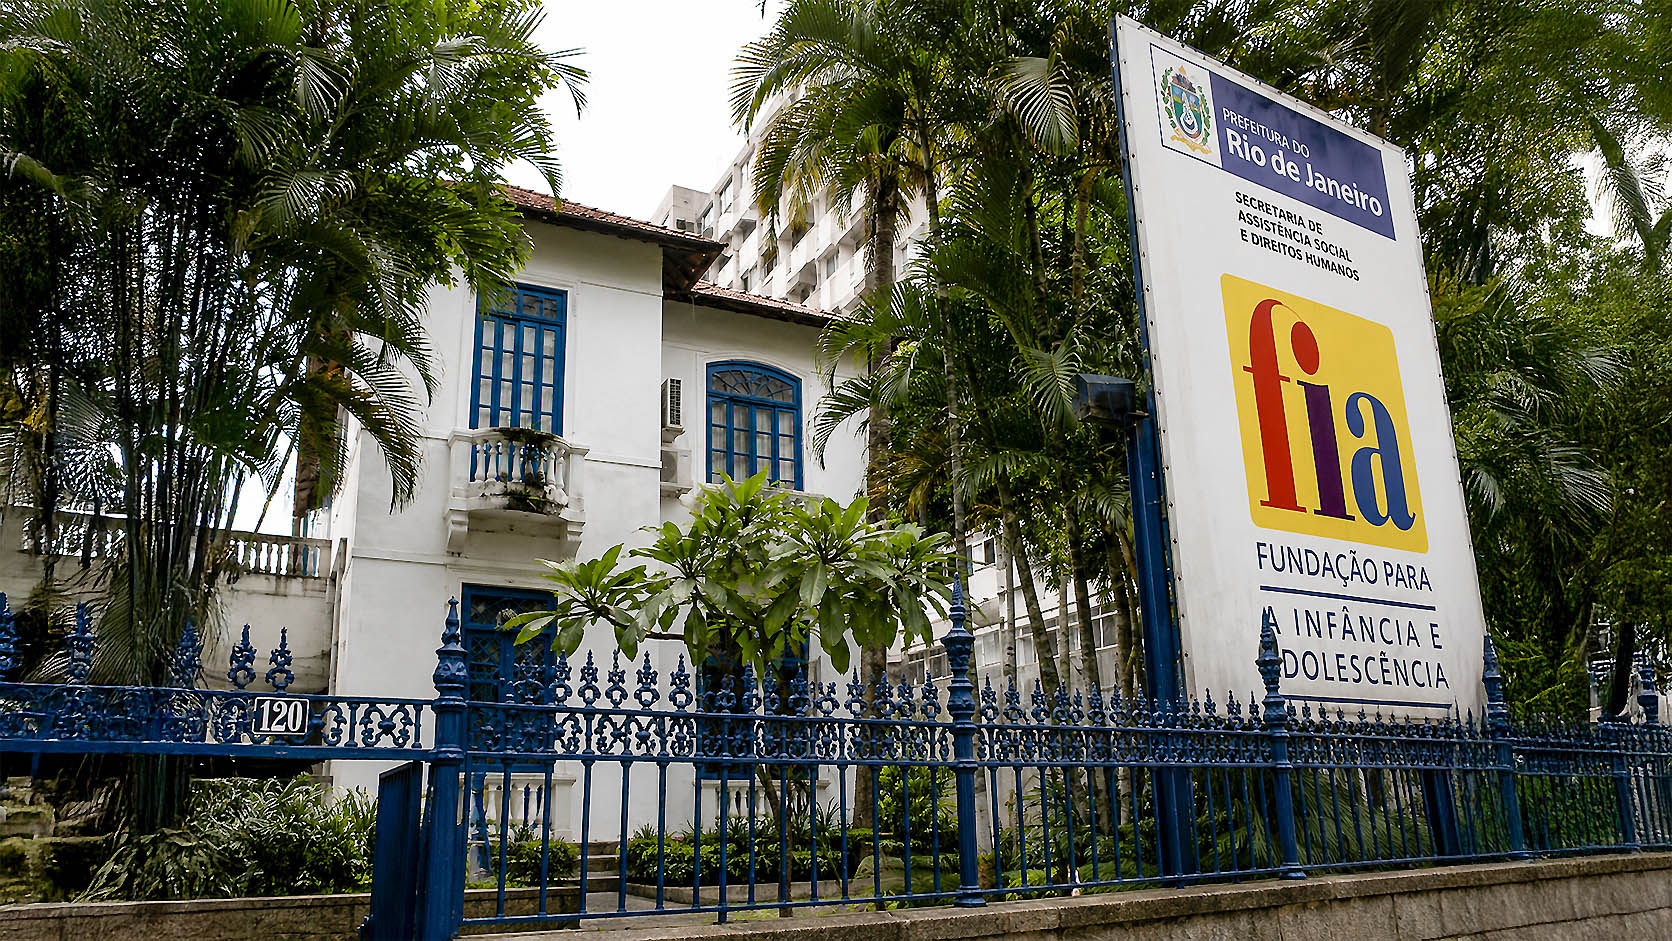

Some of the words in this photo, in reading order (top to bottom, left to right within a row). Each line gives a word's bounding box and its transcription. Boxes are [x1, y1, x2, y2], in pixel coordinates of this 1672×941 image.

[1222, 107, 1289, 149] PREFEITURA
[1292, 138, 1310, 159] DO
[1226, 128, 1266, 167] Rio
[1271, 150, 1300, 182] de
[1305, 162, 1383, 218] Janeiro
[1235, 191, 1305, 228] SECRETARIA
[1307, 219, 1323, 235] DE
[1237, 209, 1313, 248] ASSISTÊNCIA
[1314, 238, 1352, 263] SOCIAL
[1240, 228, 1248, 242] E
[1251, 232, 1303, 262] DIREITOS
[1305, 252, 1360, 282] HUMANOS
[1242, 298, 1417, 531] fia
[1256, 541, 1378, 588] FUNDAÇÃO
[1383, 560, 1433, 592] PARA
[1264, 605, 1281, 635] A
[1293, 605, 1420, 648] INFÂNCIA
[1429, 622, 1443, 650] E
[1281, 648, 1450, 690] DOLESCÊNCIA
[260, 700, 303, 732] 120
